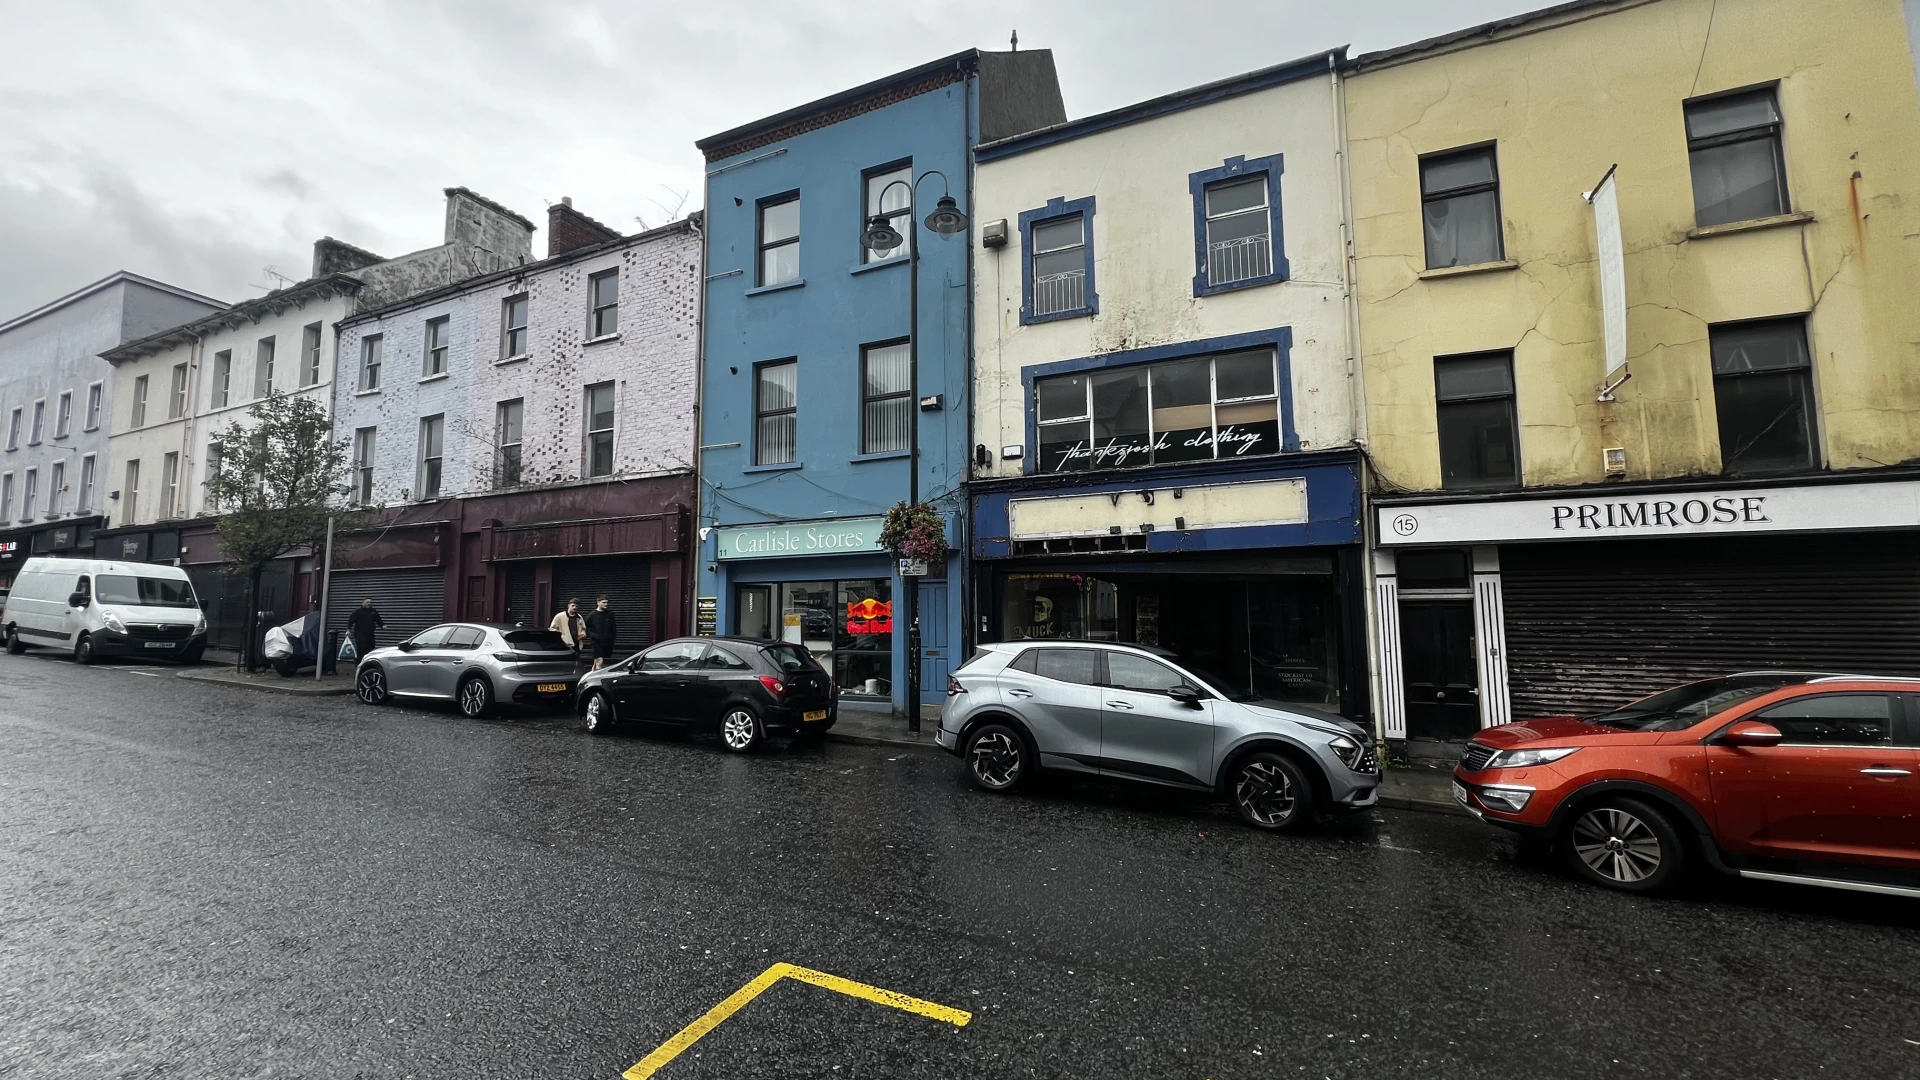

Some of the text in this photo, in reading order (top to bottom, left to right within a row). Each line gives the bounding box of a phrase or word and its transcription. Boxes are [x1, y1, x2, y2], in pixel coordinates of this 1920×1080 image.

[1184, 425, 1263, 455] clothing
[1551, 496, 1772, 531] PRIMROSE
[1397, 519, 1414, 532] 15
[735, 527, 864, 553] Carlisle Stores
[719, 549, 727, 557] 11
[847, 620, 870, 634] Red
